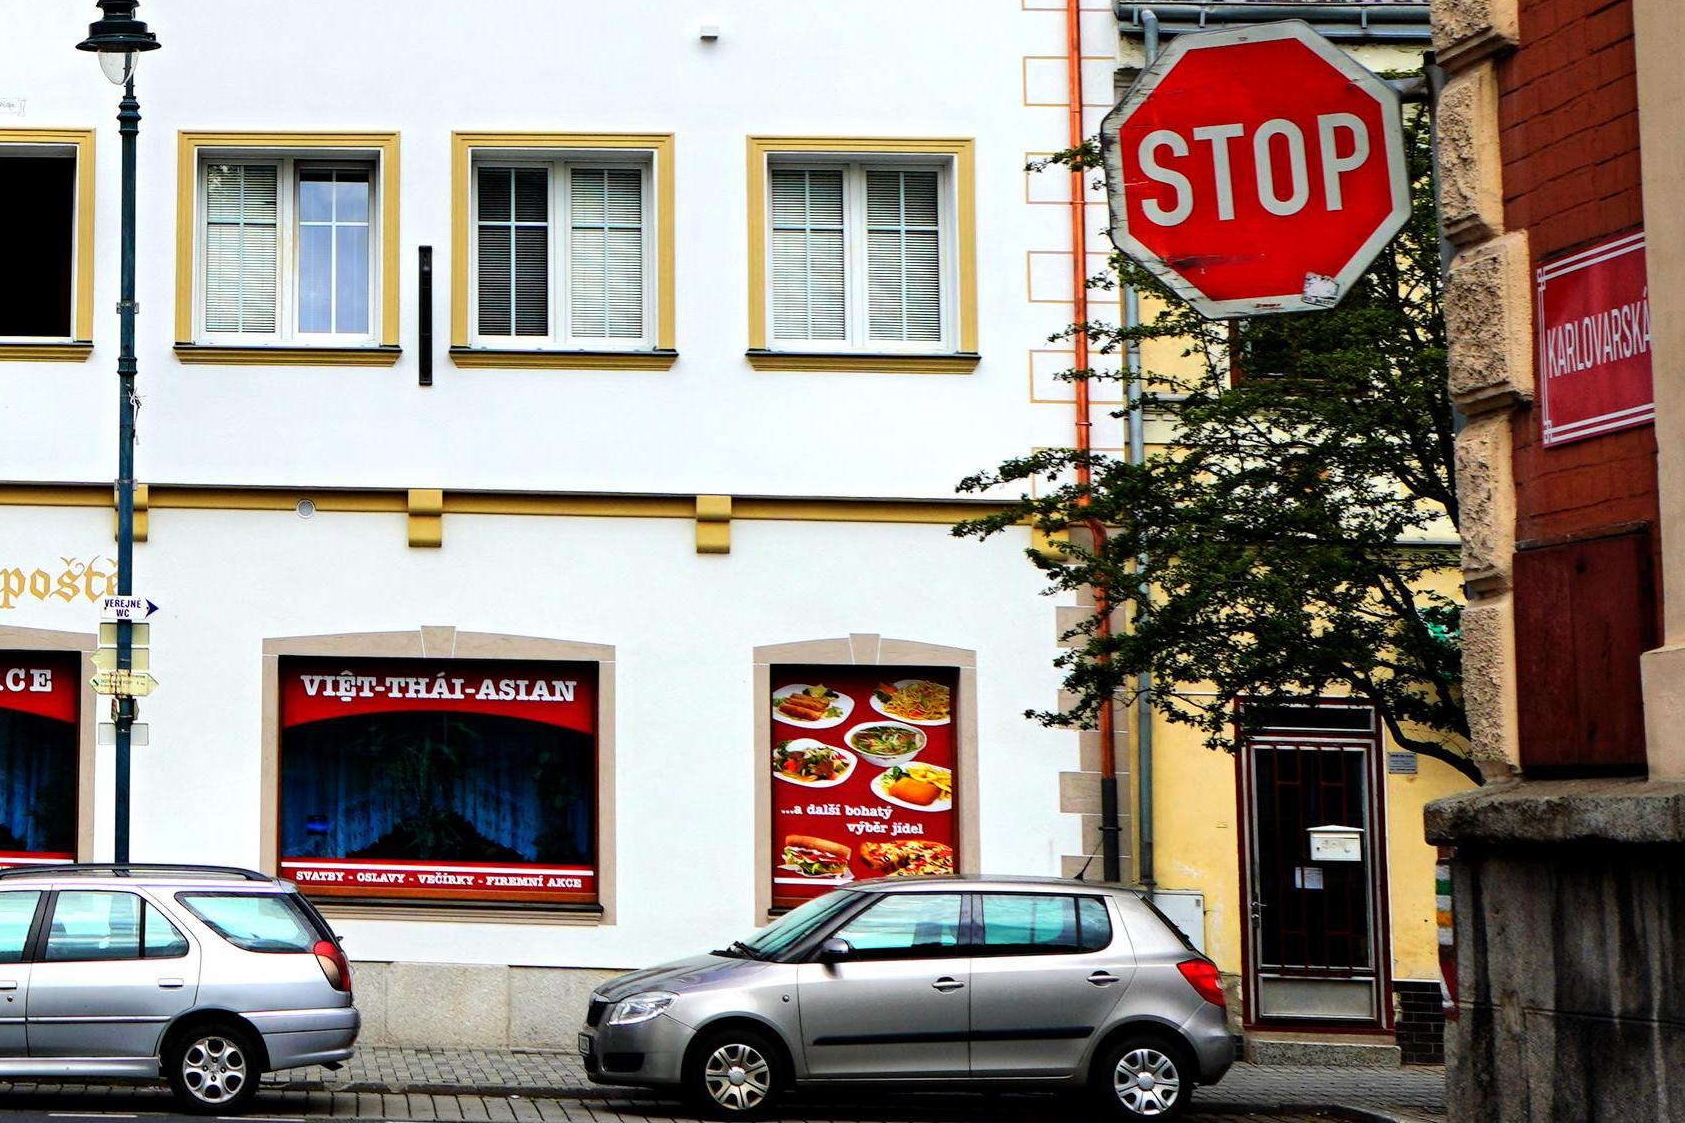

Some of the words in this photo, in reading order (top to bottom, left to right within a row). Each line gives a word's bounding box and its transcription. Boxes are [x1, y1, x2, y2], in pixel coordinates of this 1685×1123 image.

[1138, 112, 1370, 226] STOP
[1547, 285, 1651, 378] KARLOVARSKÁ
[105, 597, 141, 609] VEŘEJNÉ
[116, 609, 130, 617] WC
[807, 803, 841, 816] další
[845, 804, 893, 819] bohatý
[846, 821, 888, 835] výběr
[891, 822, 924, 836] jídel
[296, 871, 345, 882] SVATBY
[357, 873, 407, 884] OSLAVY
[417, 872, 475, 886] VEČÍRKY
[486, 875, 544, 888] FIREMNÍ
[547, 877, 582, 889] AKCE
